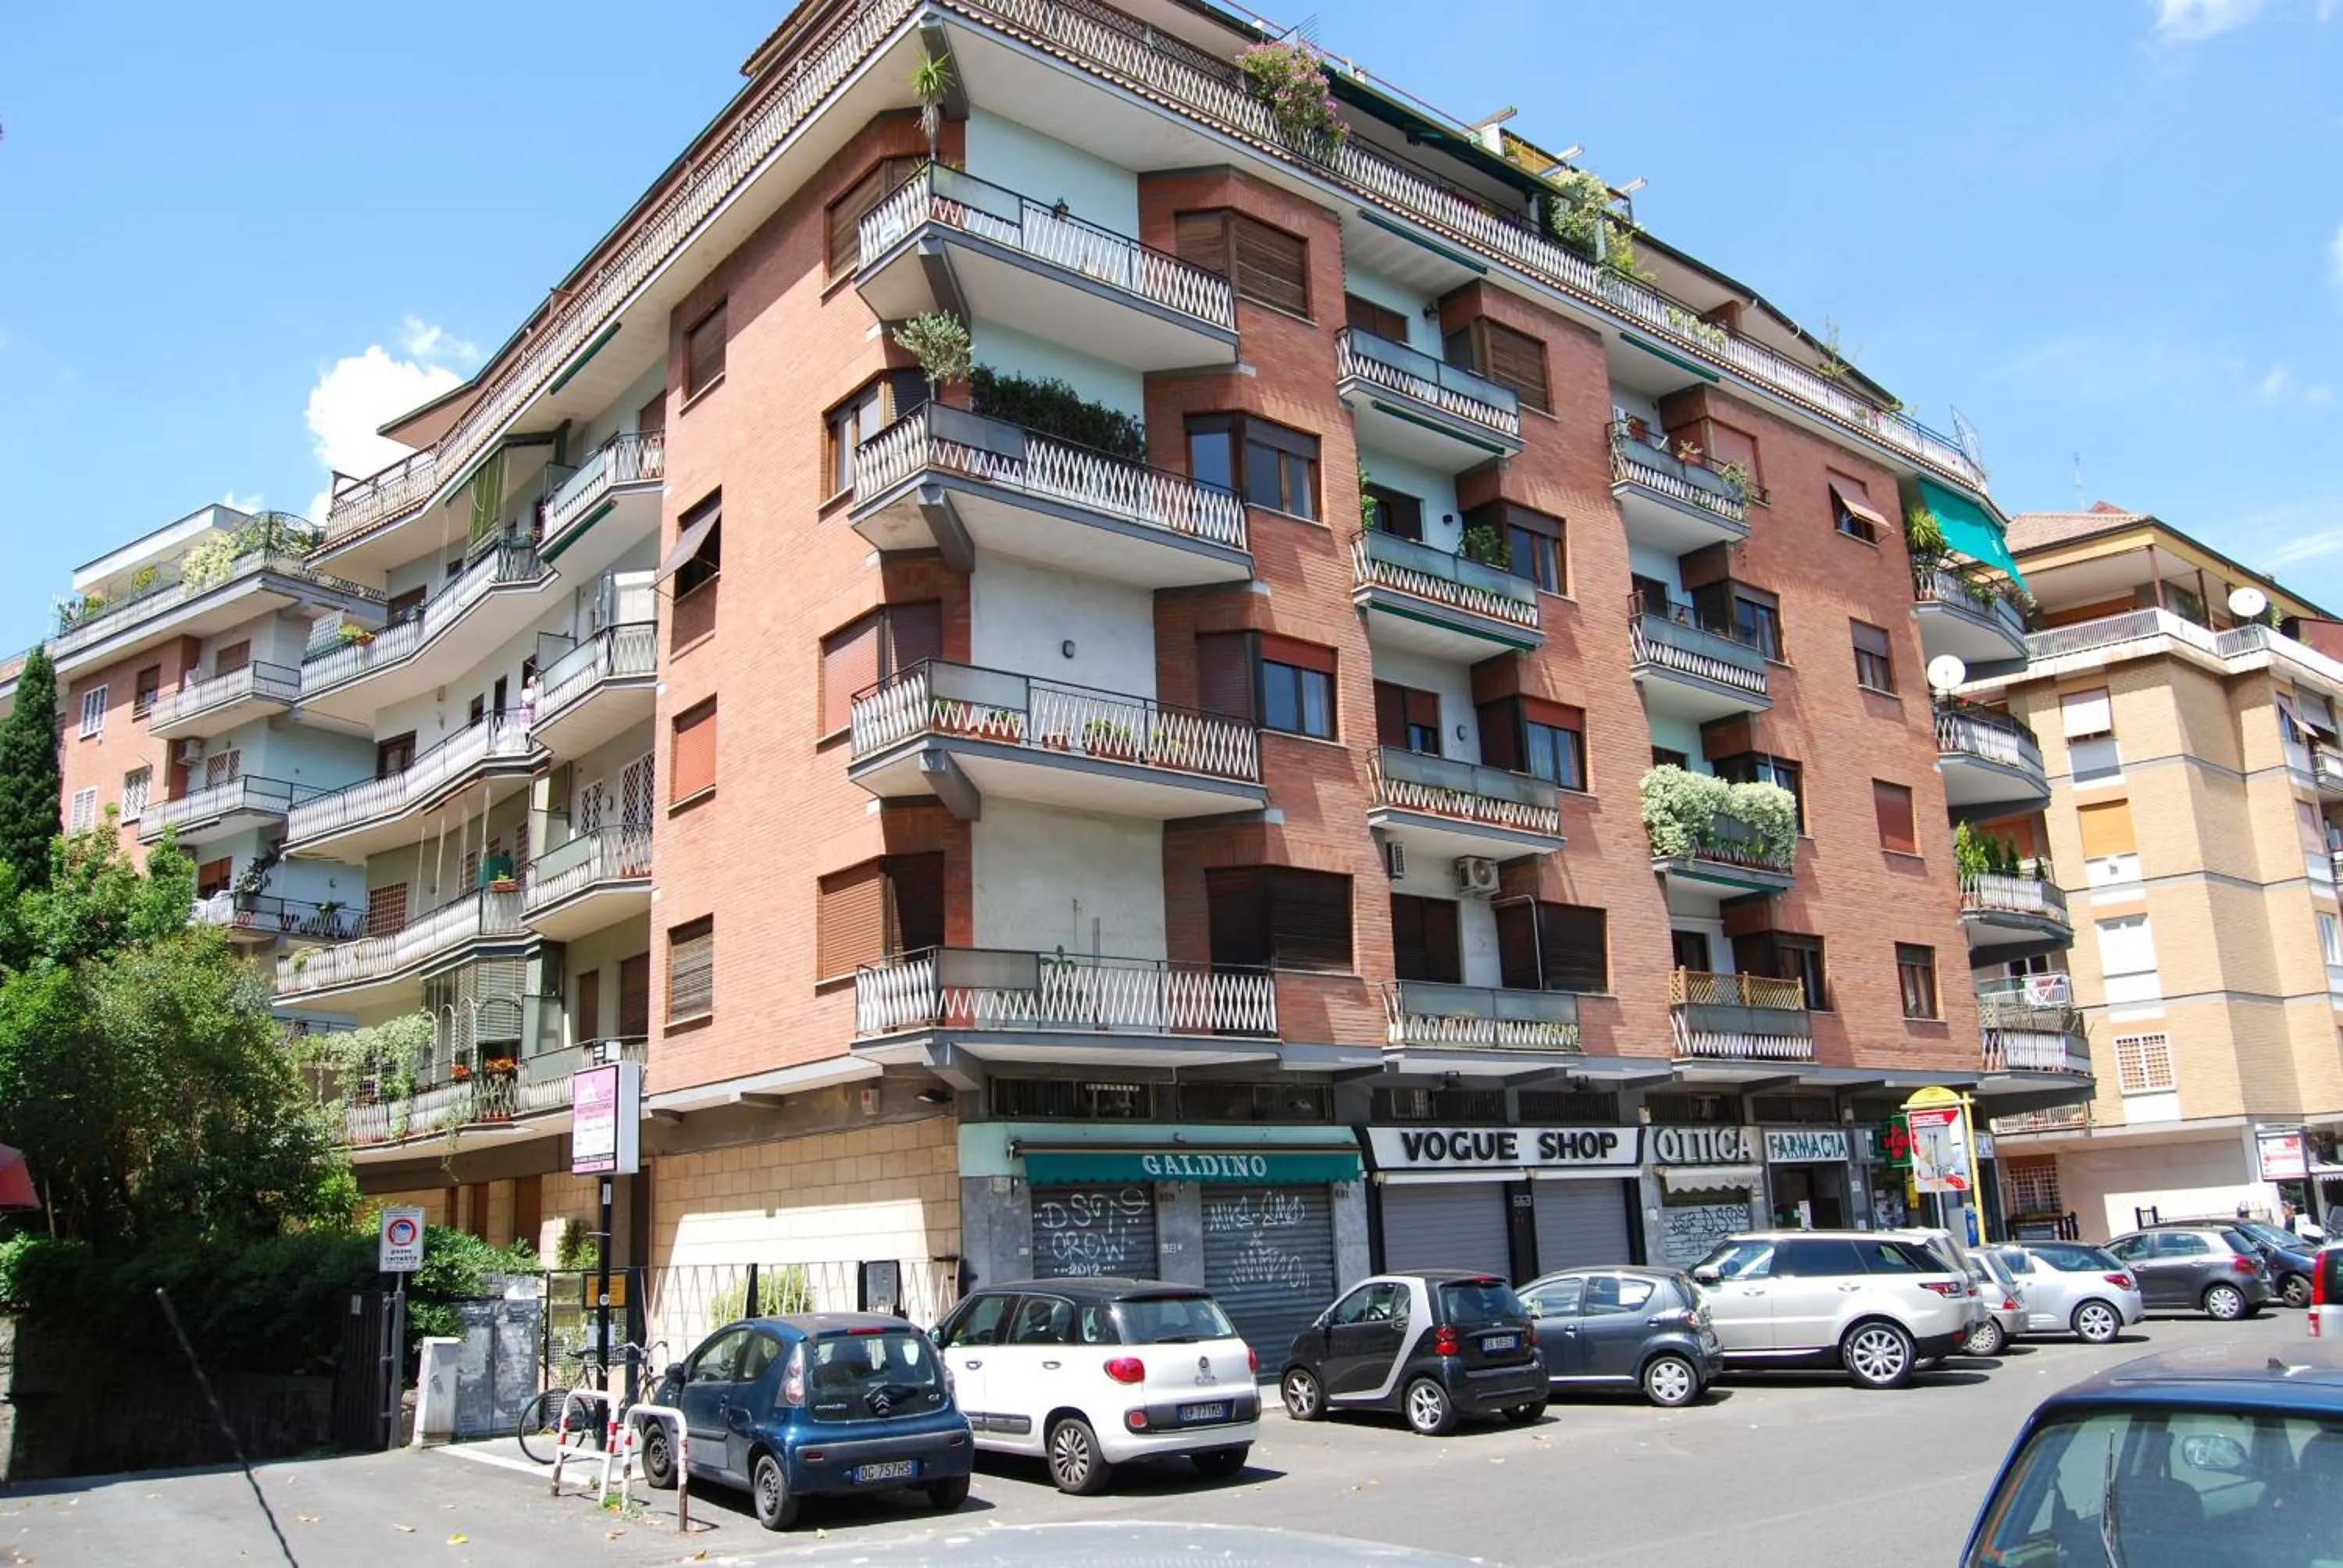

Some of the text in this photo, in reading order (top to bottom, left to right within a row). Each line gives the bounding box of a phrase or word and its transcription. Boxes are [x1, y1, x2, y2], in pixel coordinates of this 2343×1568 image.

[1401, 1131, 1618, 1162] VOGUE SHOP
[1656, 1127, 1756, 1161] OTTICA
[1767, 1133, 1847, 1159] FARMACIA
[1141, 1154, 1268, 1178] GALDINO
[1051, 1228, 1125, 1261] CREW
